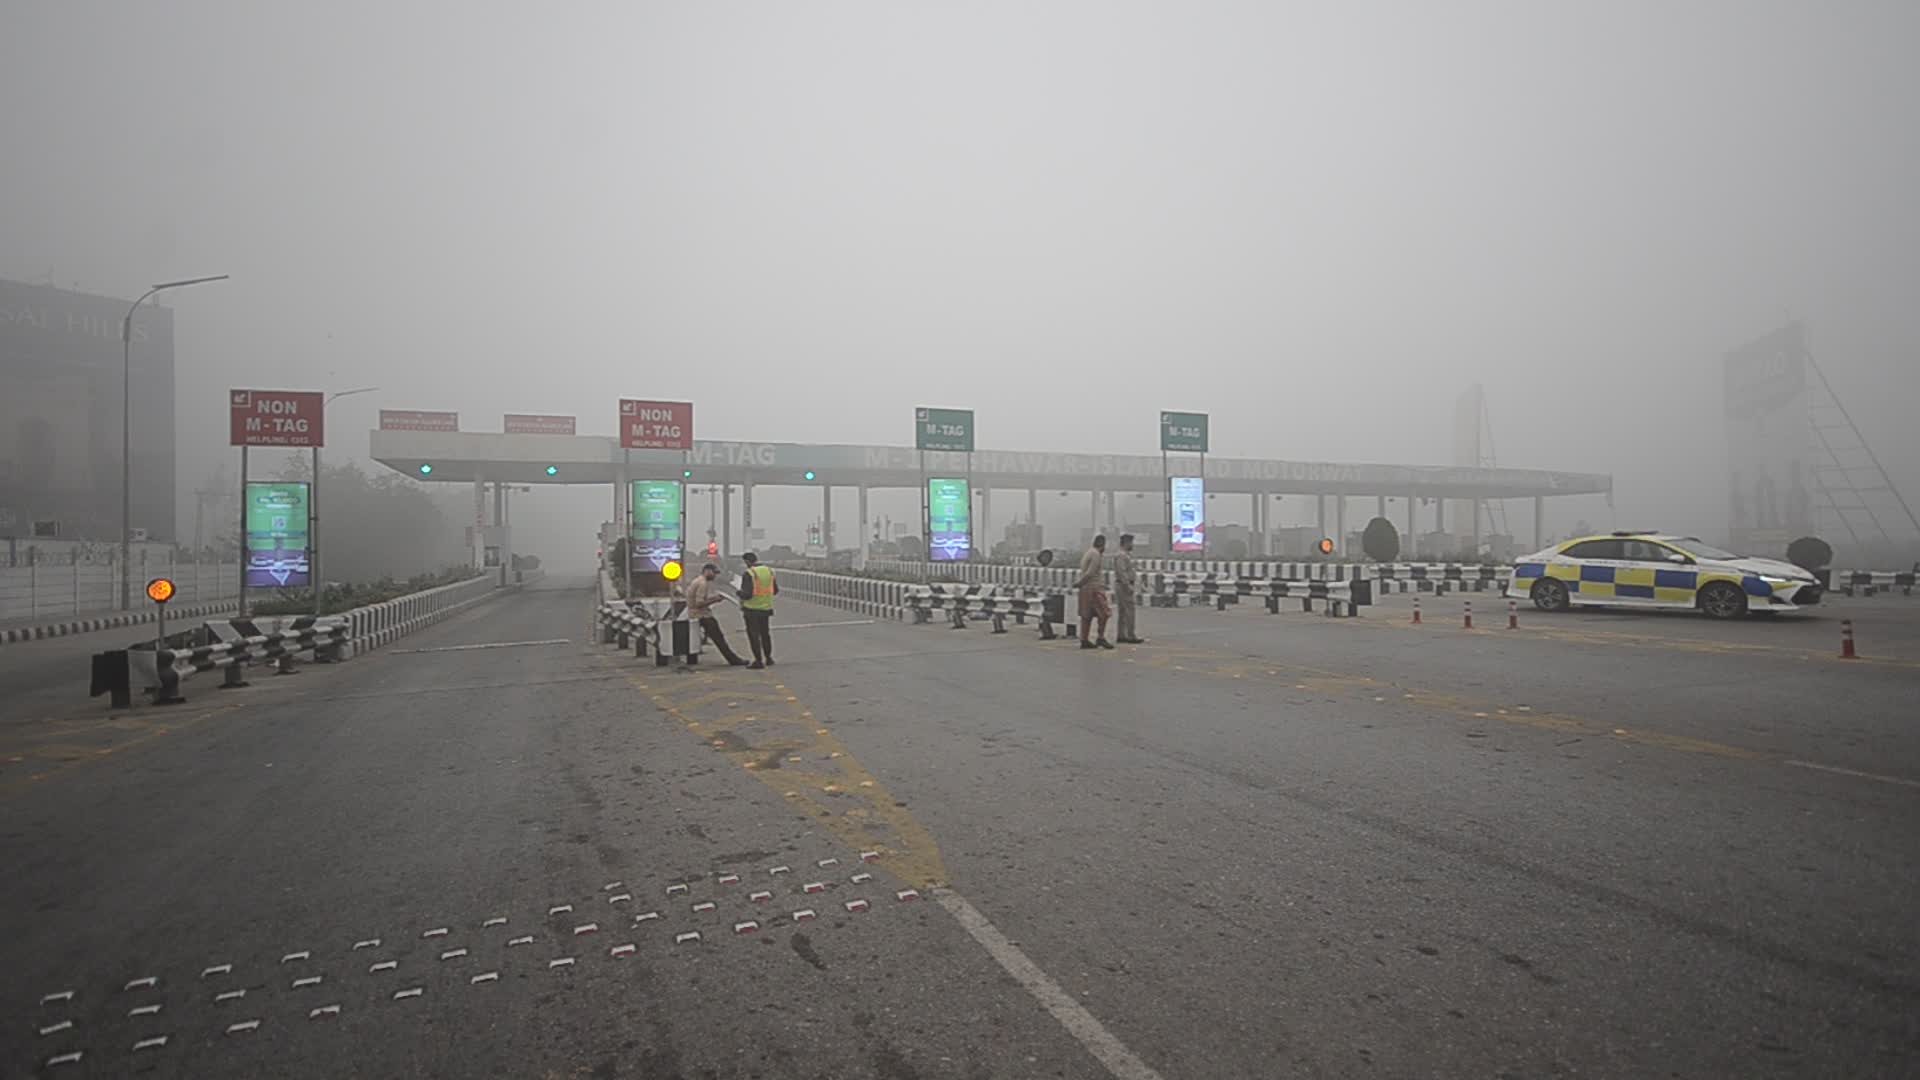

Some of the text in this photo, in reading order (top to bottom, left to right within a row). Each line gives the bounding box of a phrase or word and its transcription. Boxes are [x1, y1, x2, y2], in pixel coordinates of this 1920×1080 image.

[257, 399, 297, 414] NON
[640, 408, 673, 421] NON
[686, 442, 776, 465] M-TAG
